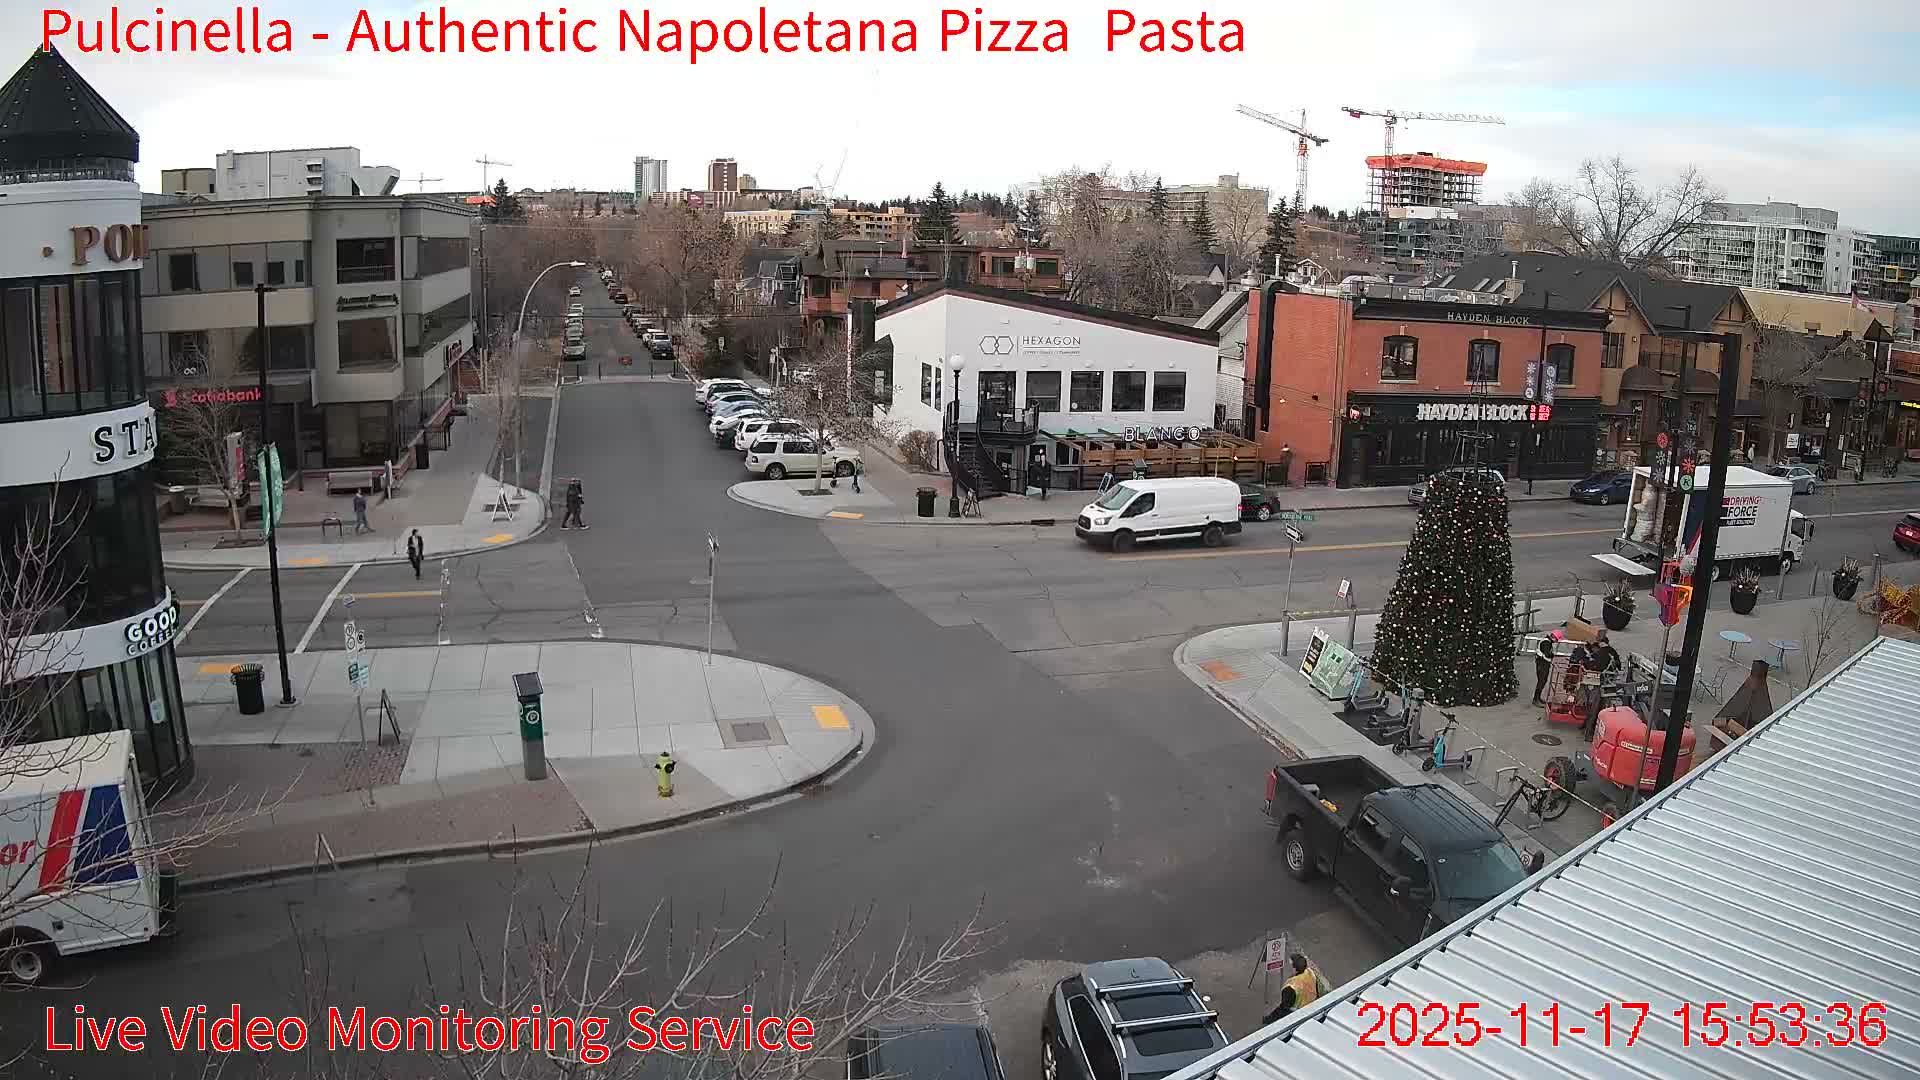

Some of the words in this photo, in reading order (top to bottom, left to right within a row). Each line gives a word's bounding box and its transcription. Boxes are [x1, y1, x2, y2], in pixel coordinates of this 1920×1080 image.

[1447, 311, 1490, 323] HAYDEN
[1495, 315, 1529, 325] BLOCK
[1022, 335, 1081, 346] HEXAGON
[1416, 403, 1479, 421] HAYDEN
[1479, 403, 1529, 421] BLOCK
[1124, 426, 1201, 442] BLANCO
[1729, 496, 1761, 506] DRIVING
[1728, 506, 1758, 517] FORCE
[125, 606, 177, 643] GOOD
